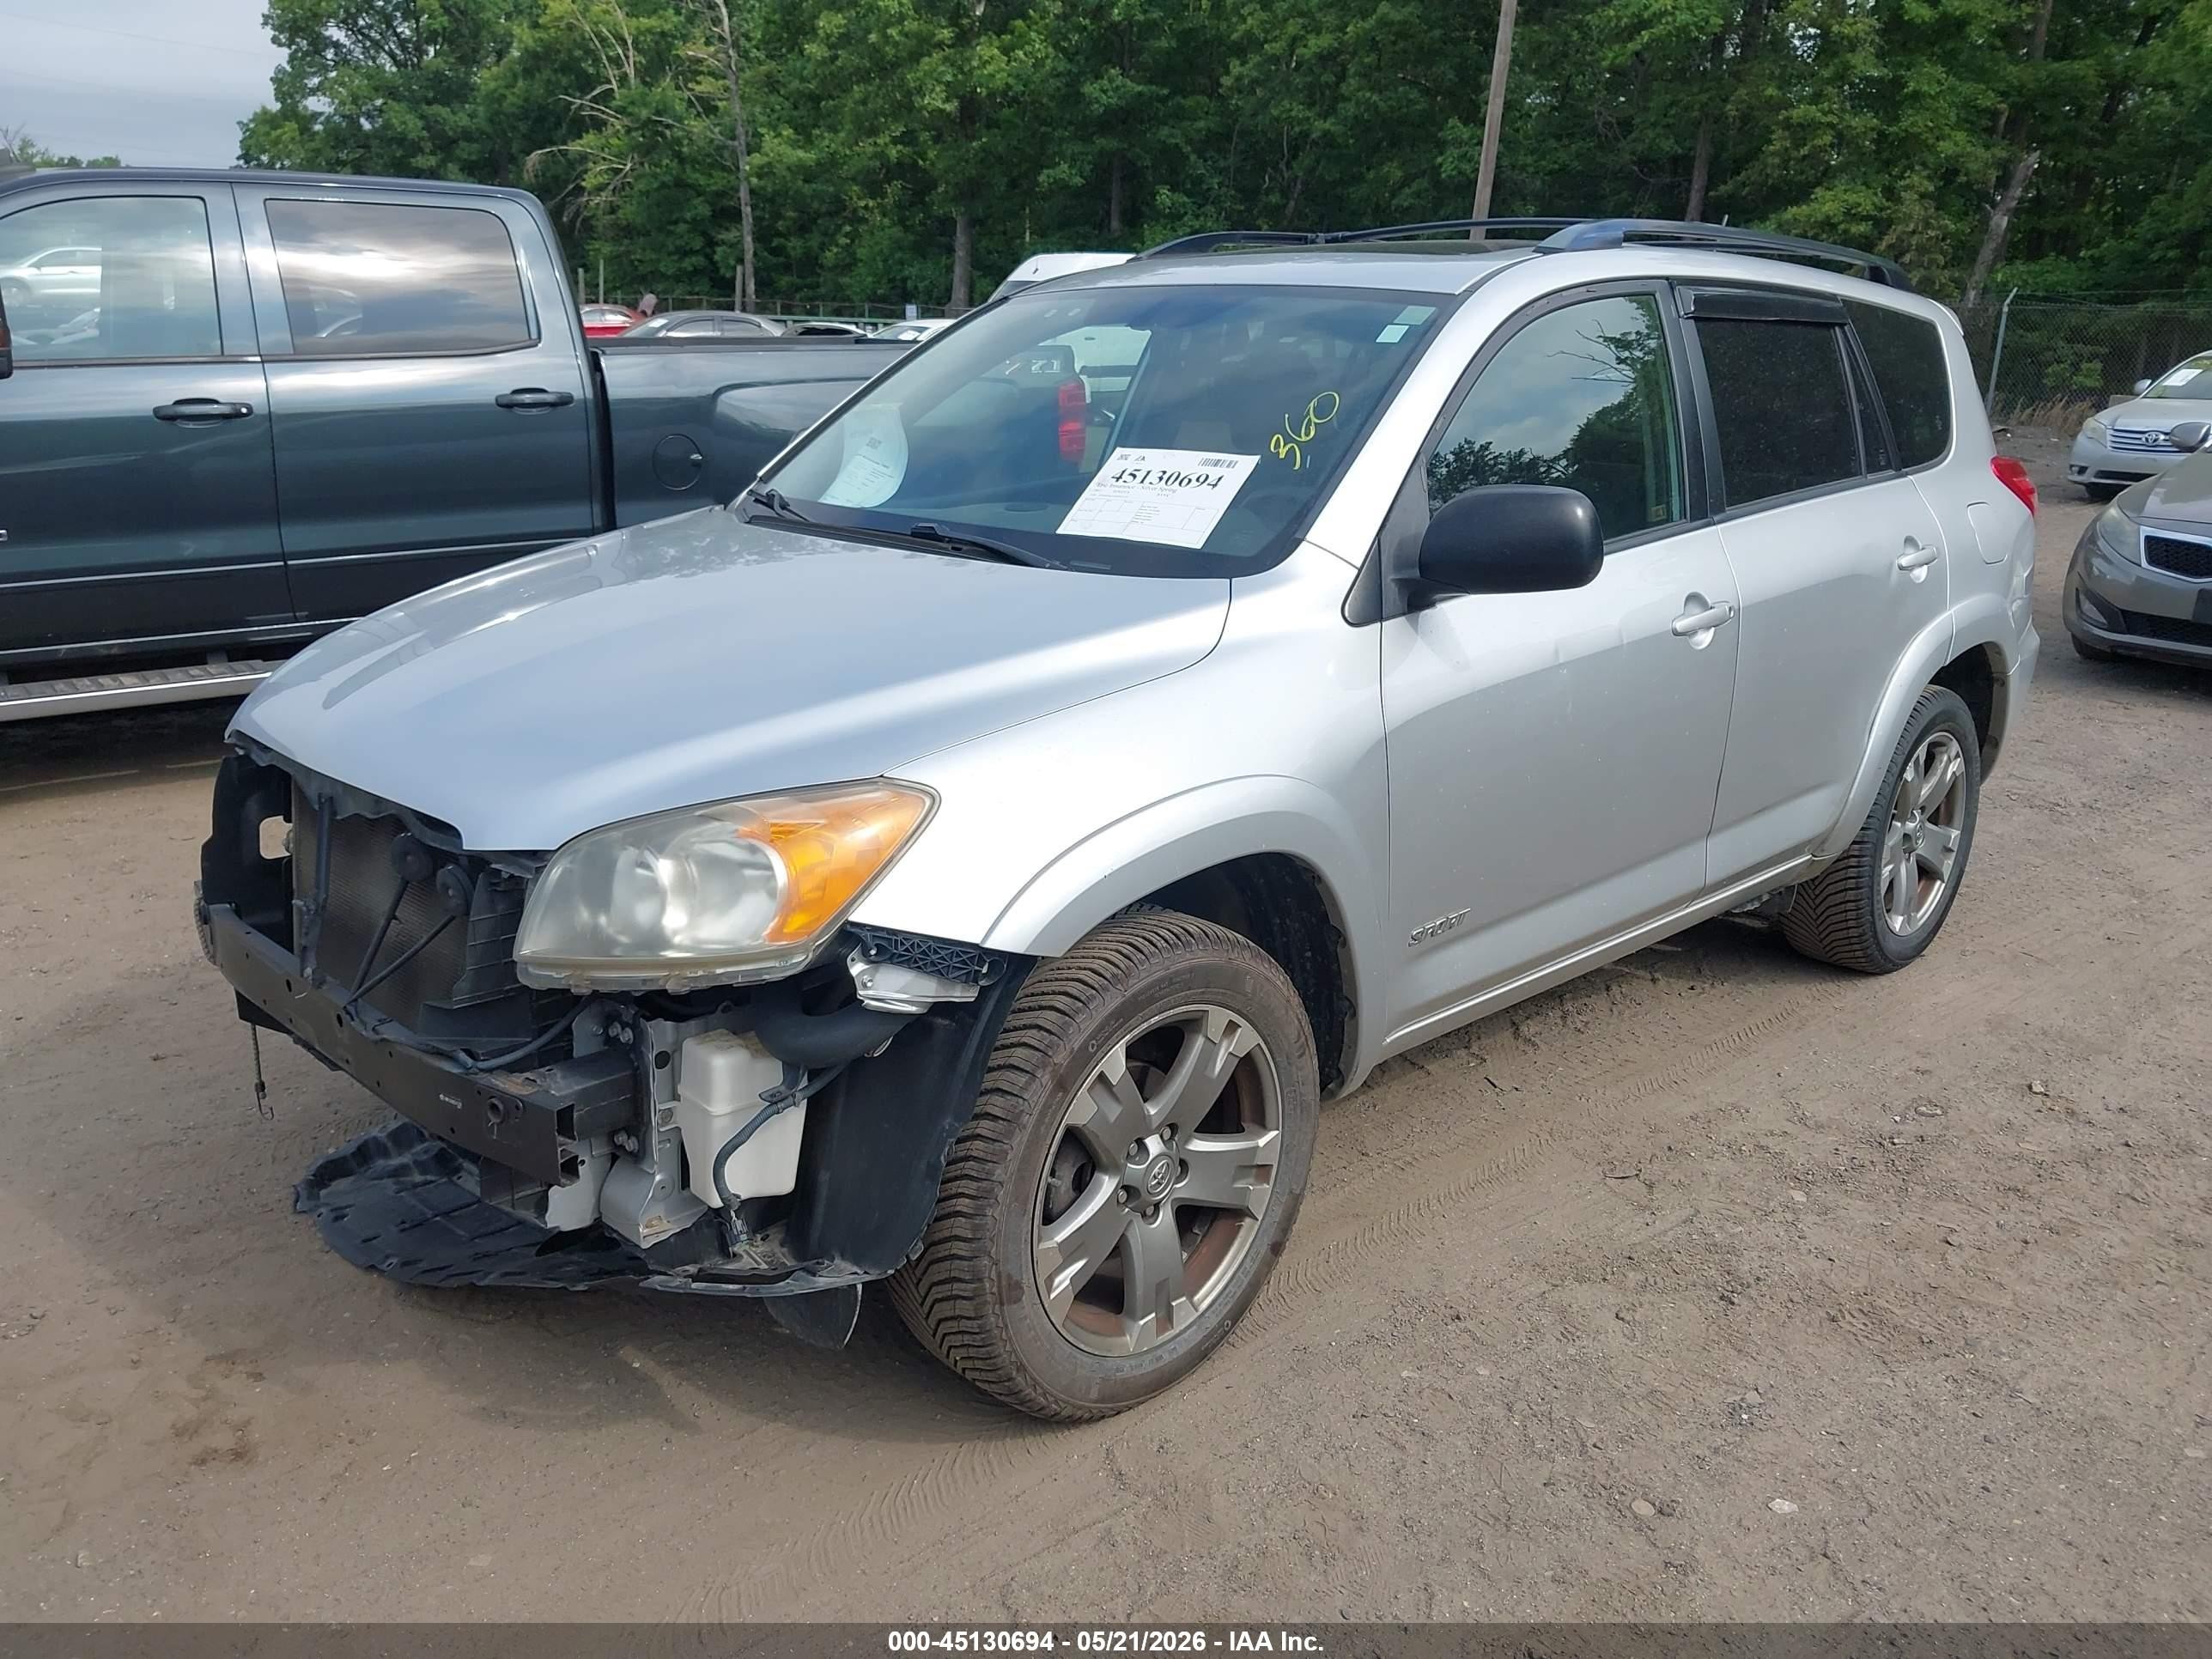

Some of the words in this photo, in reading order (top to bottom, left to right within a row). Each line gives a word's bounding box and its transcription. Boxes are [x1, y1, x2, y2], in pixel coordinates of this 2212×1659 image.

[1270, 391, 1340, 471] 360
[1111, 467, 1224, 490] 45130694
[1407, 908, 1471, 947] SPORT
